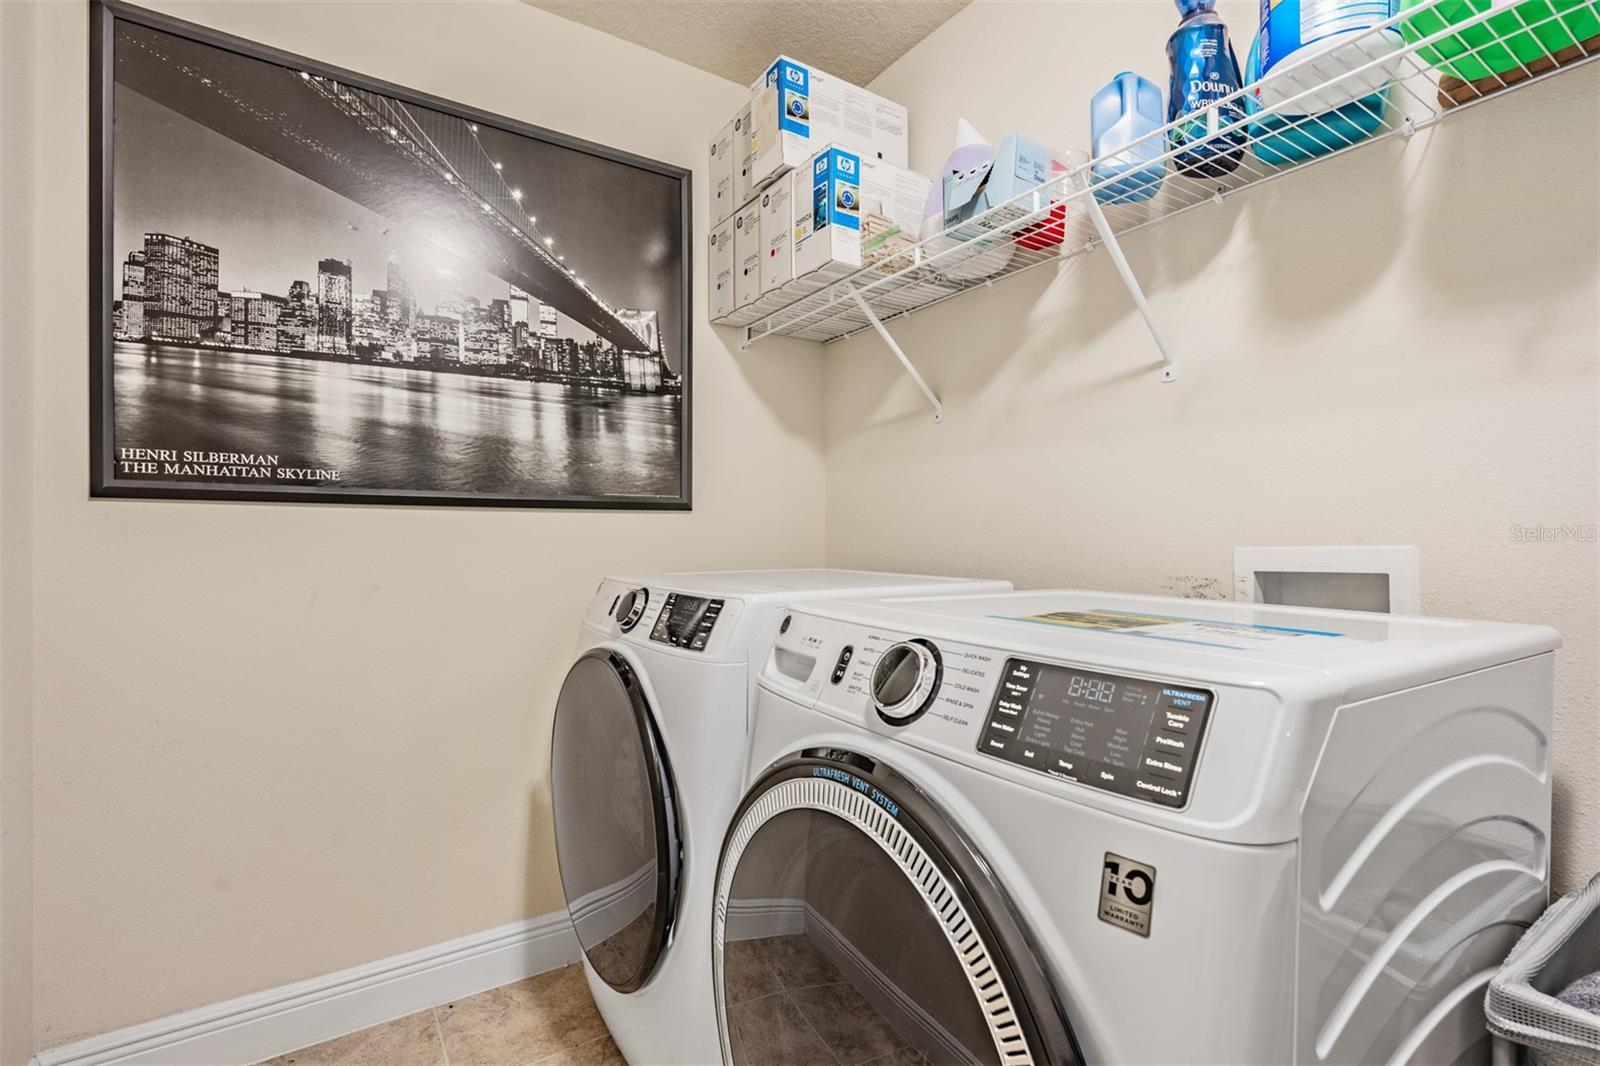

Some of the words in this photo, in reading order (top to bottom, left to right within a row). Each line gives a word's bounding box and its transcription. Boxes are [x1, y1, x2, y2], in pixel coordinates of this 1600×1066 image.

[1189, 79, 1234, 97] Downy
[121, 447, 177, 462] HENRI
[183, 450, 279, 466] SILBERMAN
[120, 461, 158, 474] THE
[164, 463, 271, 478] MANHATTAN
[277, 468, 341, 481] SKYLINE
[1162, 688, 1206, 701] ULTRAFRESH
[1173, 699, 1191, 707] VENT
[1166, 711, 1190, 722] Tumble
[1168, 720, 1184, 728] Care
[1155, 736, 1185, 749] PreWash
[1145, 757, 1163, 768] Extra
[1163, 761, 1183, 773] Rinse
[1100, 770, 1115, 781] Spin
[812, 767, 850, 784] ULTRAFRESH
[851, 776, 870, 794] VENT
[871, 788, 899, 817] SYSTEM
[1136, 780, 1161, 793] Control
[1104, 861, 1154, 906] 10
[1103, 910, 1144, 929] WARRANTY
[1110, 904, 1140, 920] LIMITED
